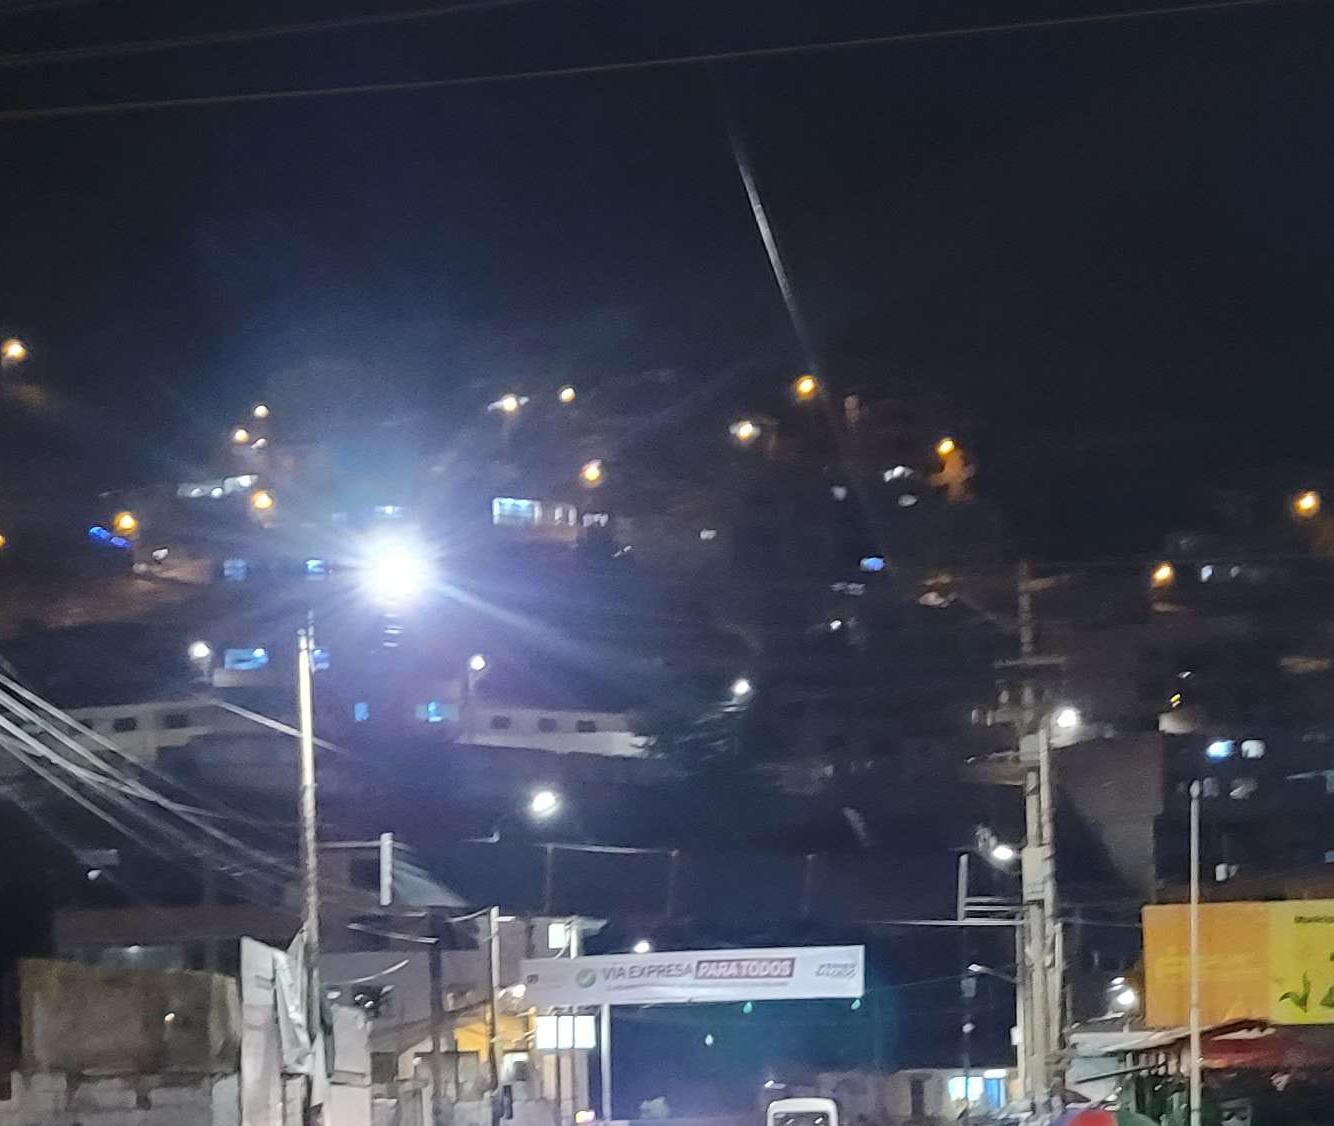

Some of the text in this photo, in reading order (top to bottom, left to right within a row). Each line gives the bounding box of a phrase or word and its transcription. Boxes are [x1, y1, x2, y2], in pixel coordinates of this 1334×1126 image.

[629, 962, 692, 979] EXPRESA
[698, 961, 737, 978] PARA
[740, 959, 792, 977] TODOS
